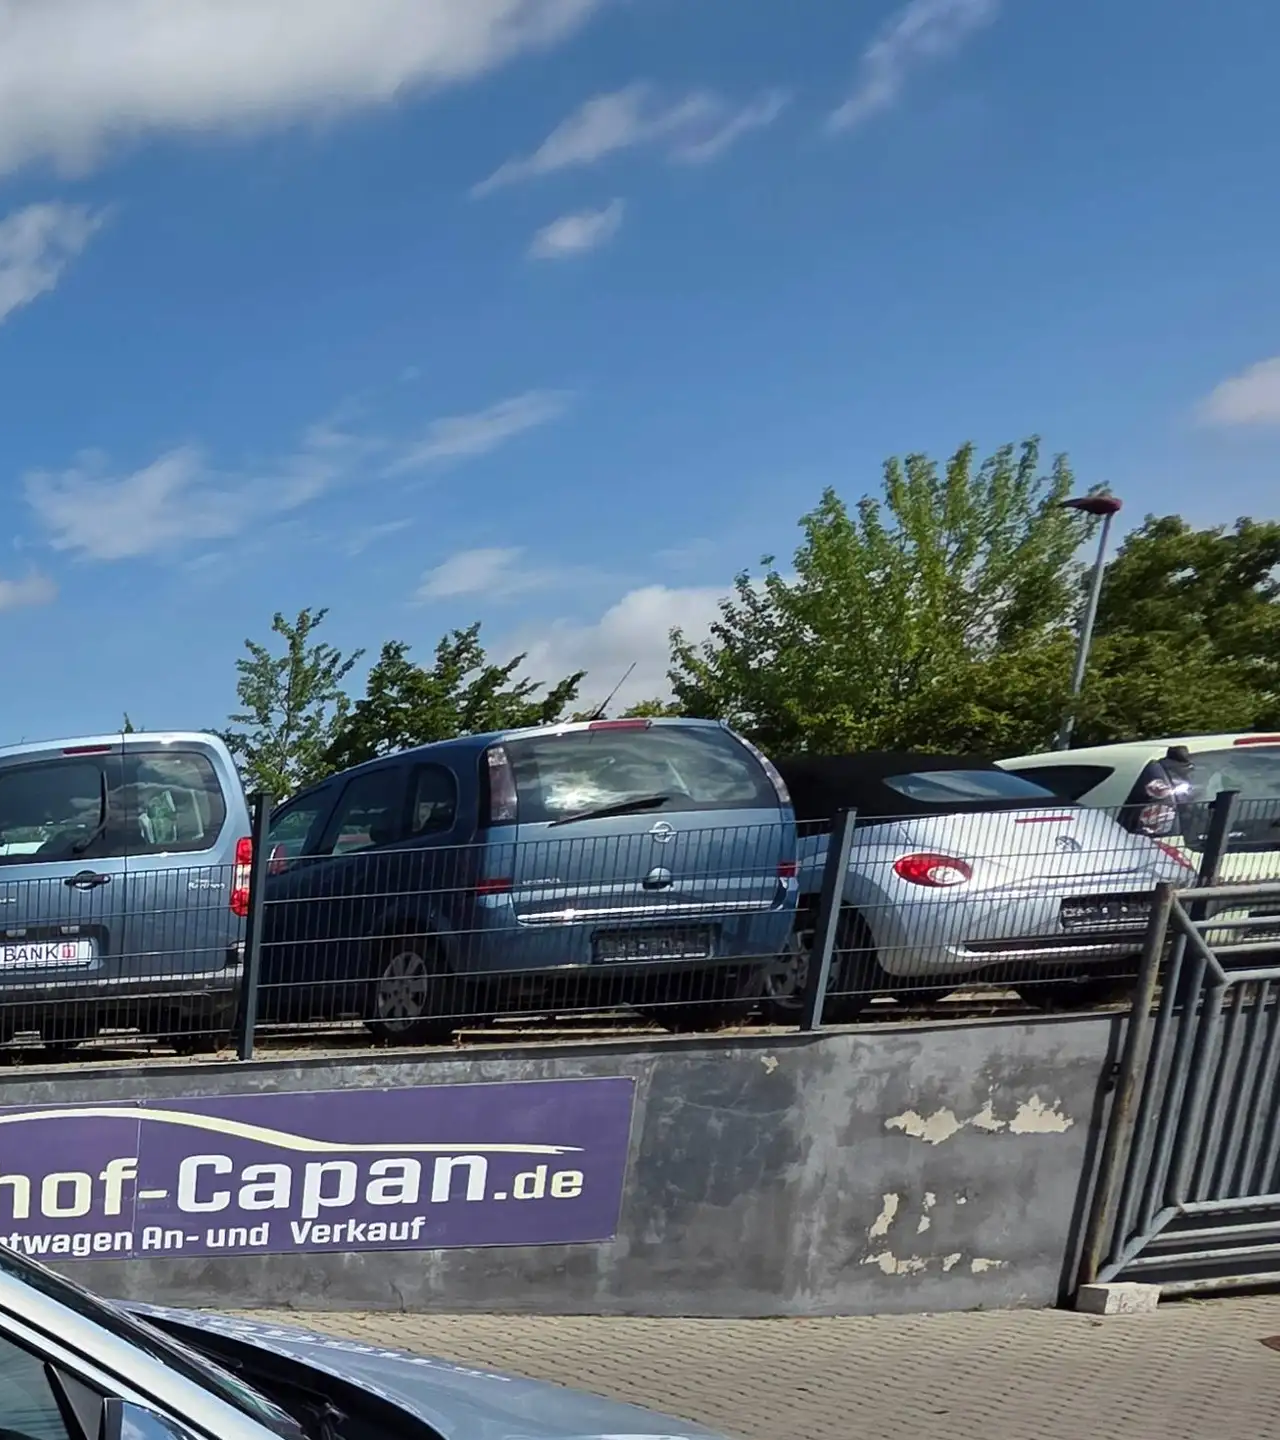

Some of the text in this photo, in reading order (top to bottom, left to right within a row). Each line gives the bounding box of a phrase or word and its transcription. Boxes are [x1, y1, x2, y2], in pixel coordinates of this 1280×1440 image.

[4, 943, 58, 962] BANK
[206, 1222, 270, 1248] und
[290, 1216, 427, 1245] Verkauf
